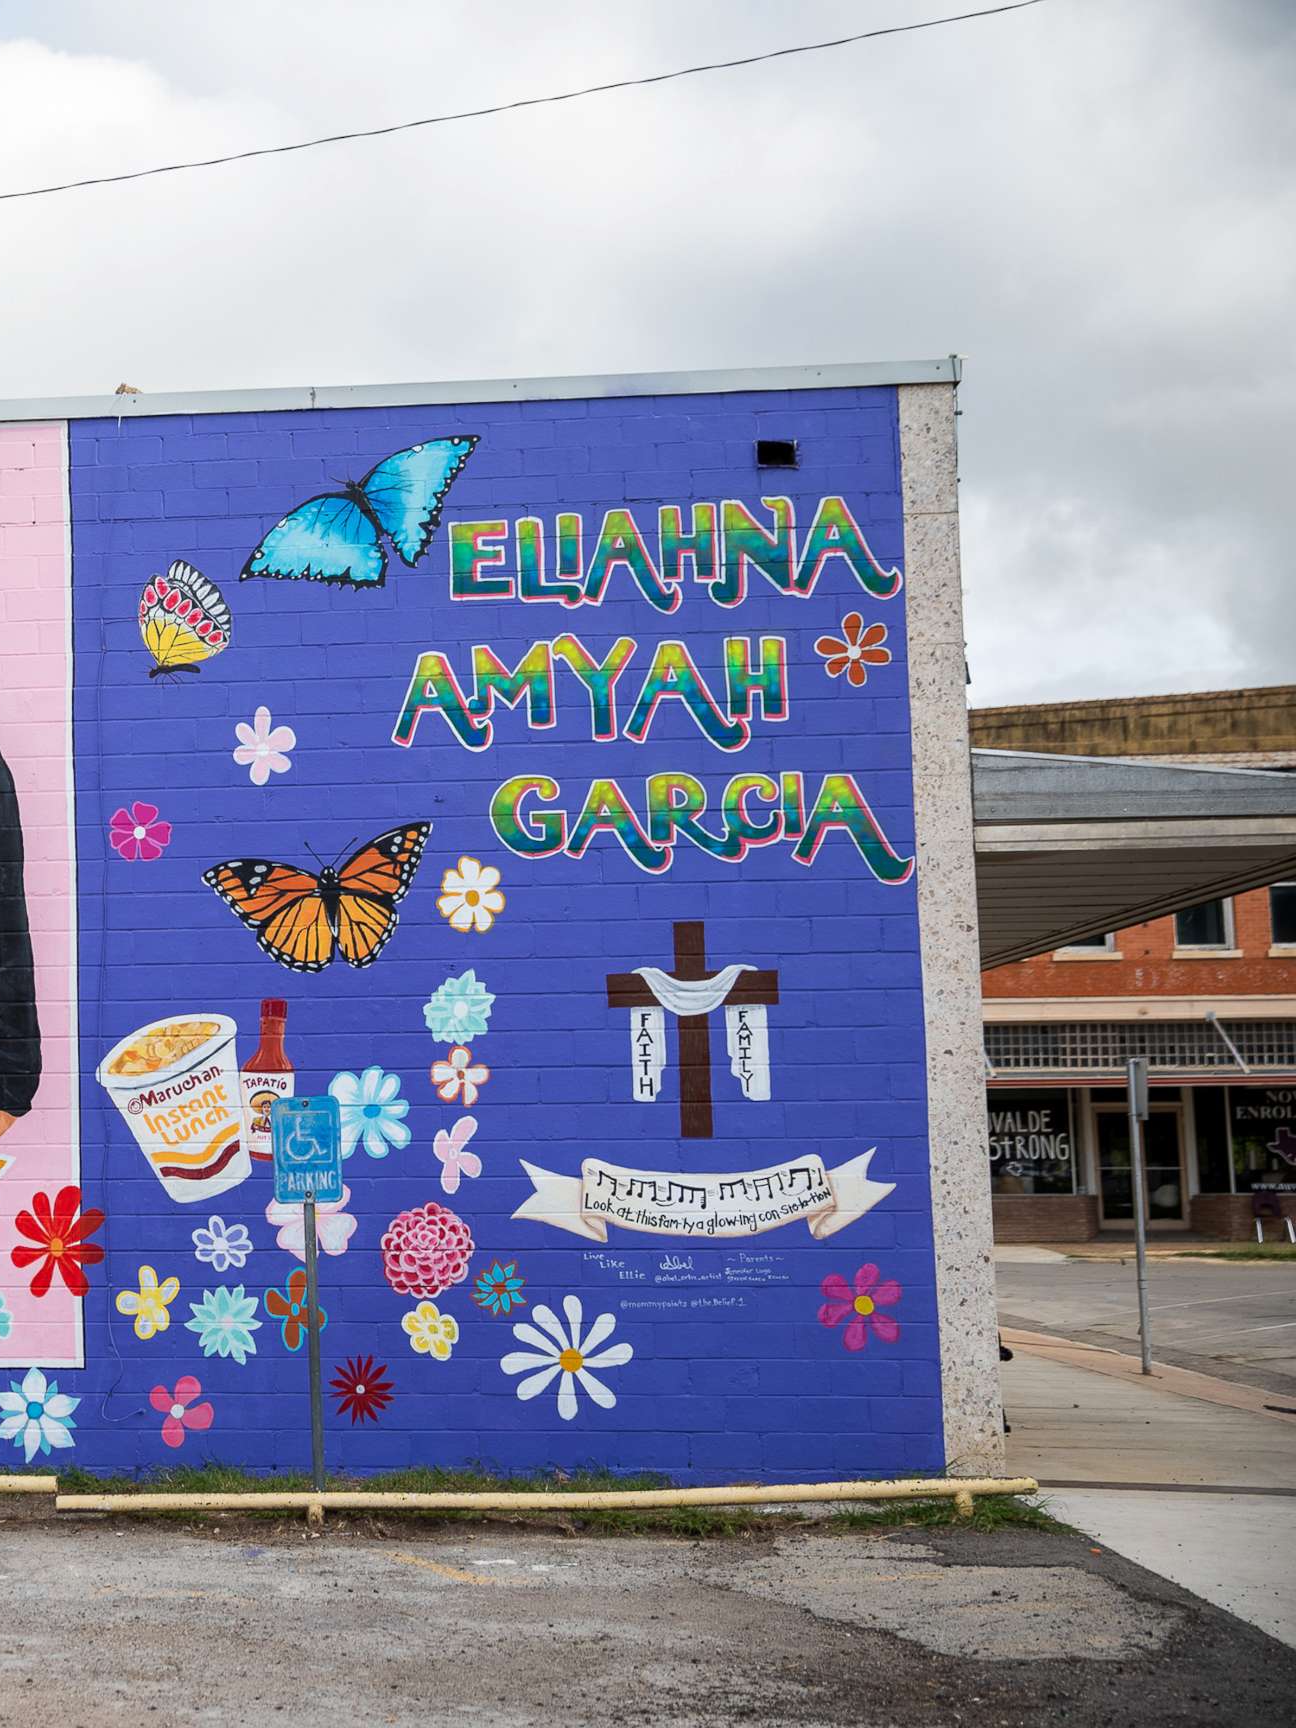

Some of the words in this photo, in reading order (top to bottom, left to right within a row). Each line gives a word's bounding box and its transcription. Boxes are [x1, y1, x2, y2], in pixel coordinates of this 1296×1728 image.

[448, 496, 901, 615] ELIAHNA
[392, 632, 789, 752] AMYAH
[490, 771, 916, 885] GARCIA
[636, 1013, 654, 1096] FAITH
[736, 1010, 754, 1092] FAMILY
[139, 1065, 223, 1107] Maruchan
[143, 1083, 228, 1134] Instant
[161, 1105, 230, 1147] Lunch
[280, 1170, 337, 1191] PARKING
[585, 1193, 615, 1214] Look
[616, 1207, 635, 1222] at
[636, 1209, 658, 1227] this
